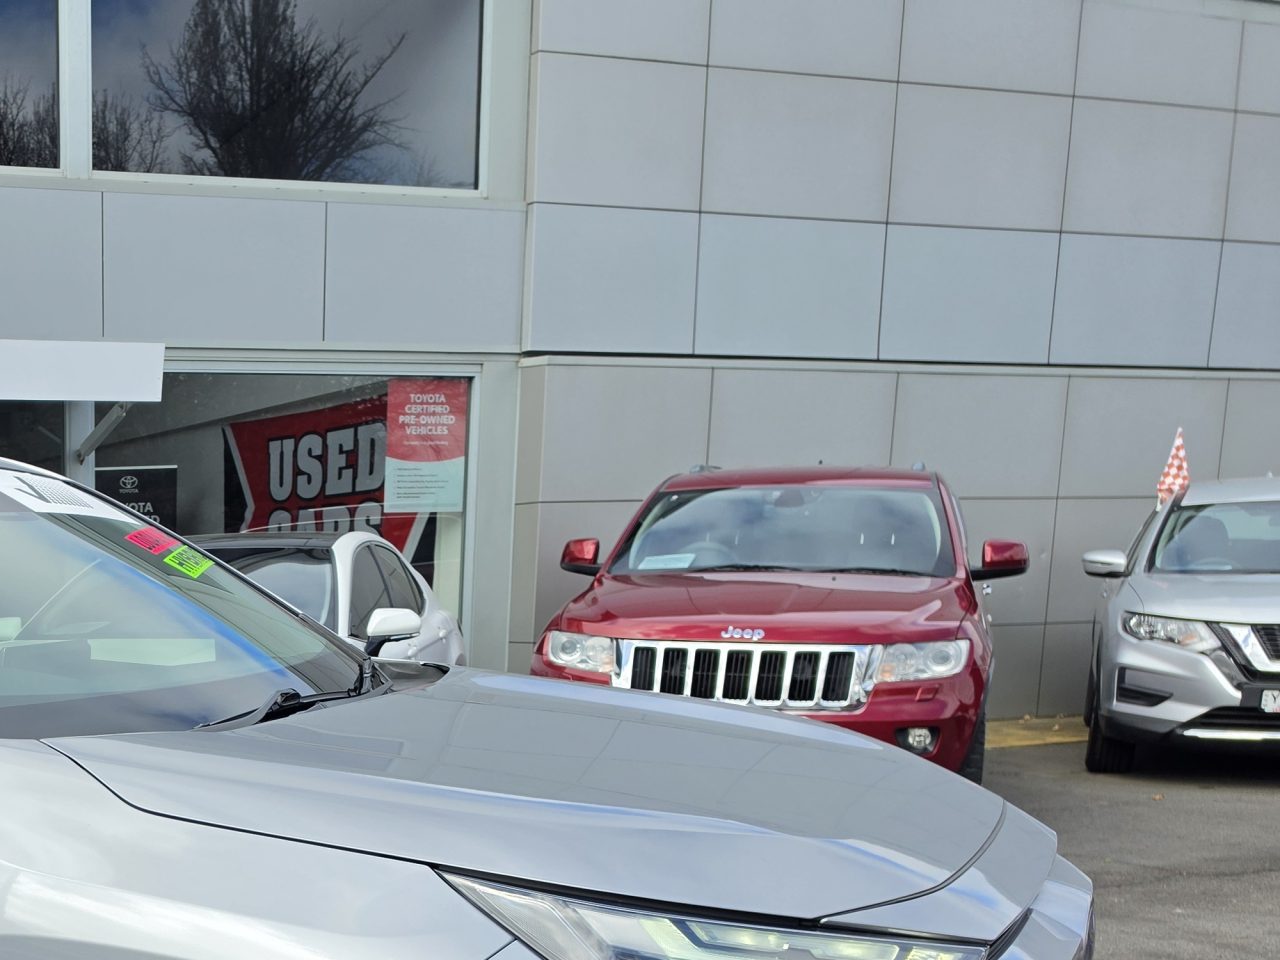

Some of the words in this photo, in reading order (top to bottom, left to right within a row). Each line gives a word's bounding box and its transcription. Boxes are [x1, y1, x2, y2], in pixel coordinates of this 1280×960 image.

[409, 394, 447, 402] TOYOTA
[405, 405, 450, 413] CERTIFIED
[399, 415, 456, 424] PRE-OWNED
[405, 426, 449, 435] VEHICLES
[269, 422, 388, 501] USED
[721, 625, 766, 641] Jeep
